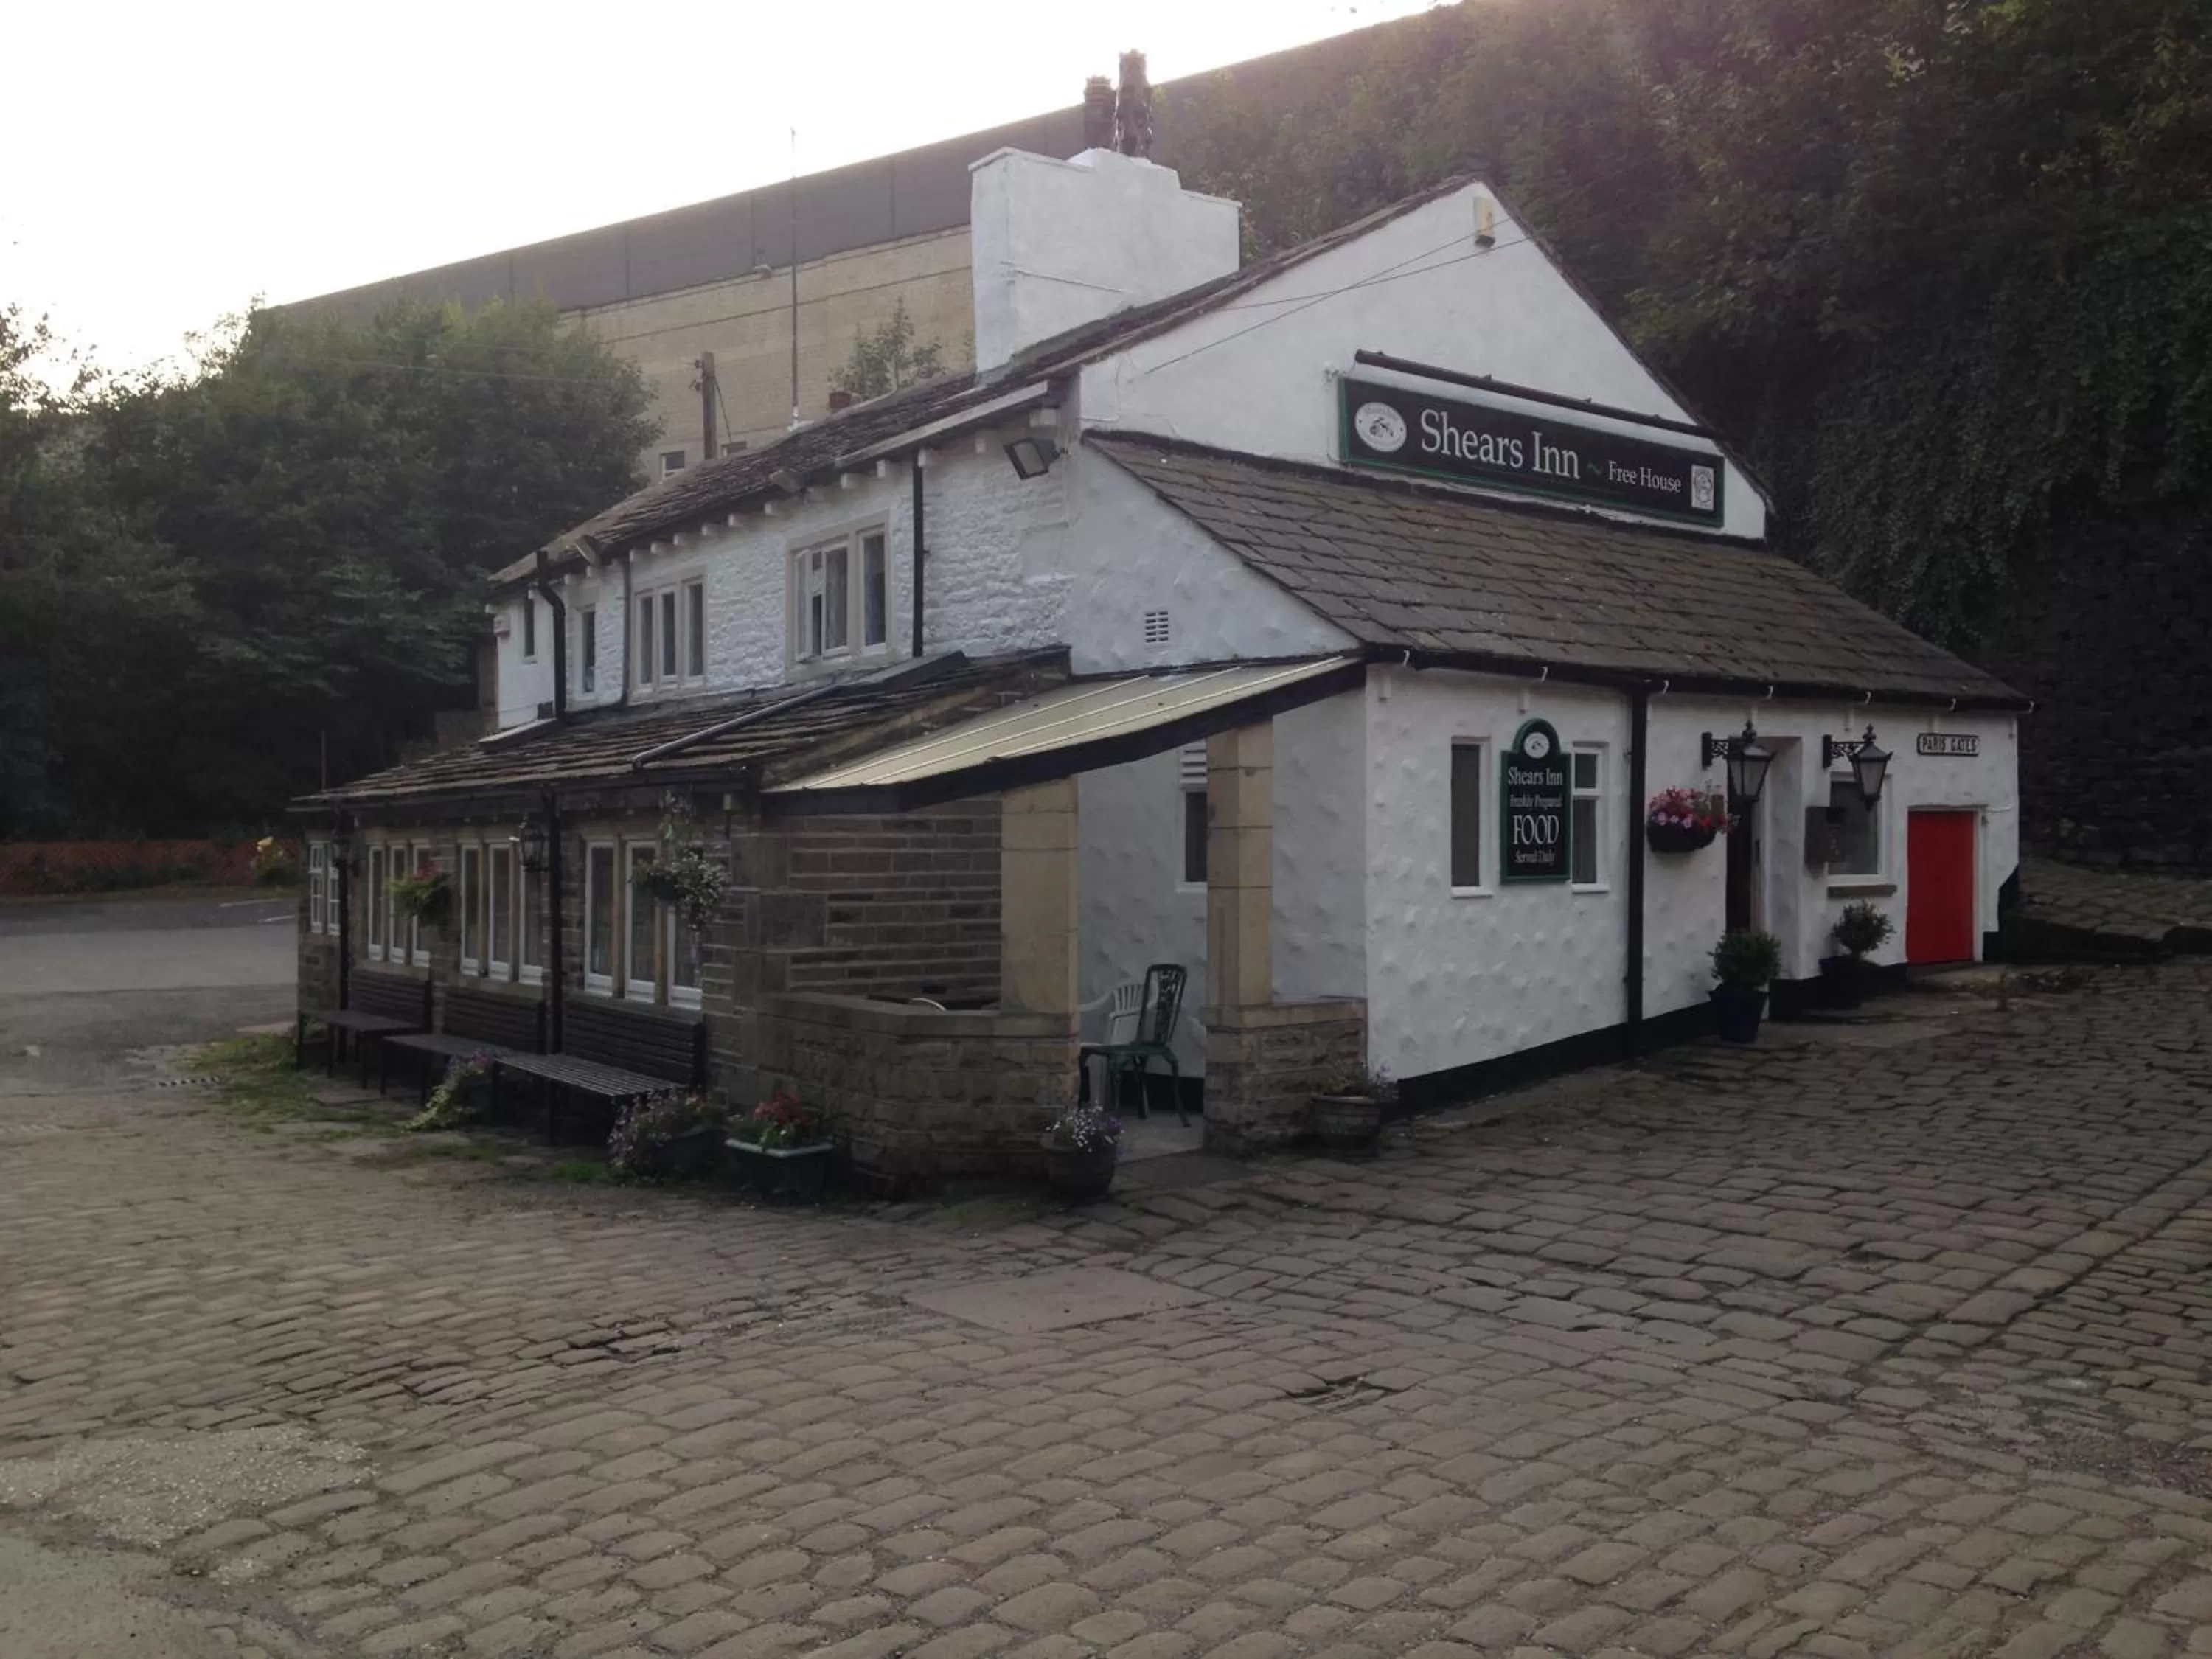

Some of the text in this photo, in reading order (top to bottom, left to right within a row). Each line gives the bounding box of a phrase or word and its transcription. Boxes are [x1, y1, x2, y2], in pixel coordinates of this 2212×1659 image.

[1421, 408, 1580, 479] Shears Inn
[1608, 459, 1682, 493] Free House
[1922, 737, 1946, 751] PARIS
[1508, 766, 1562, 785] Shears Inn
[1513, 815, 1559, 844] FOOD
